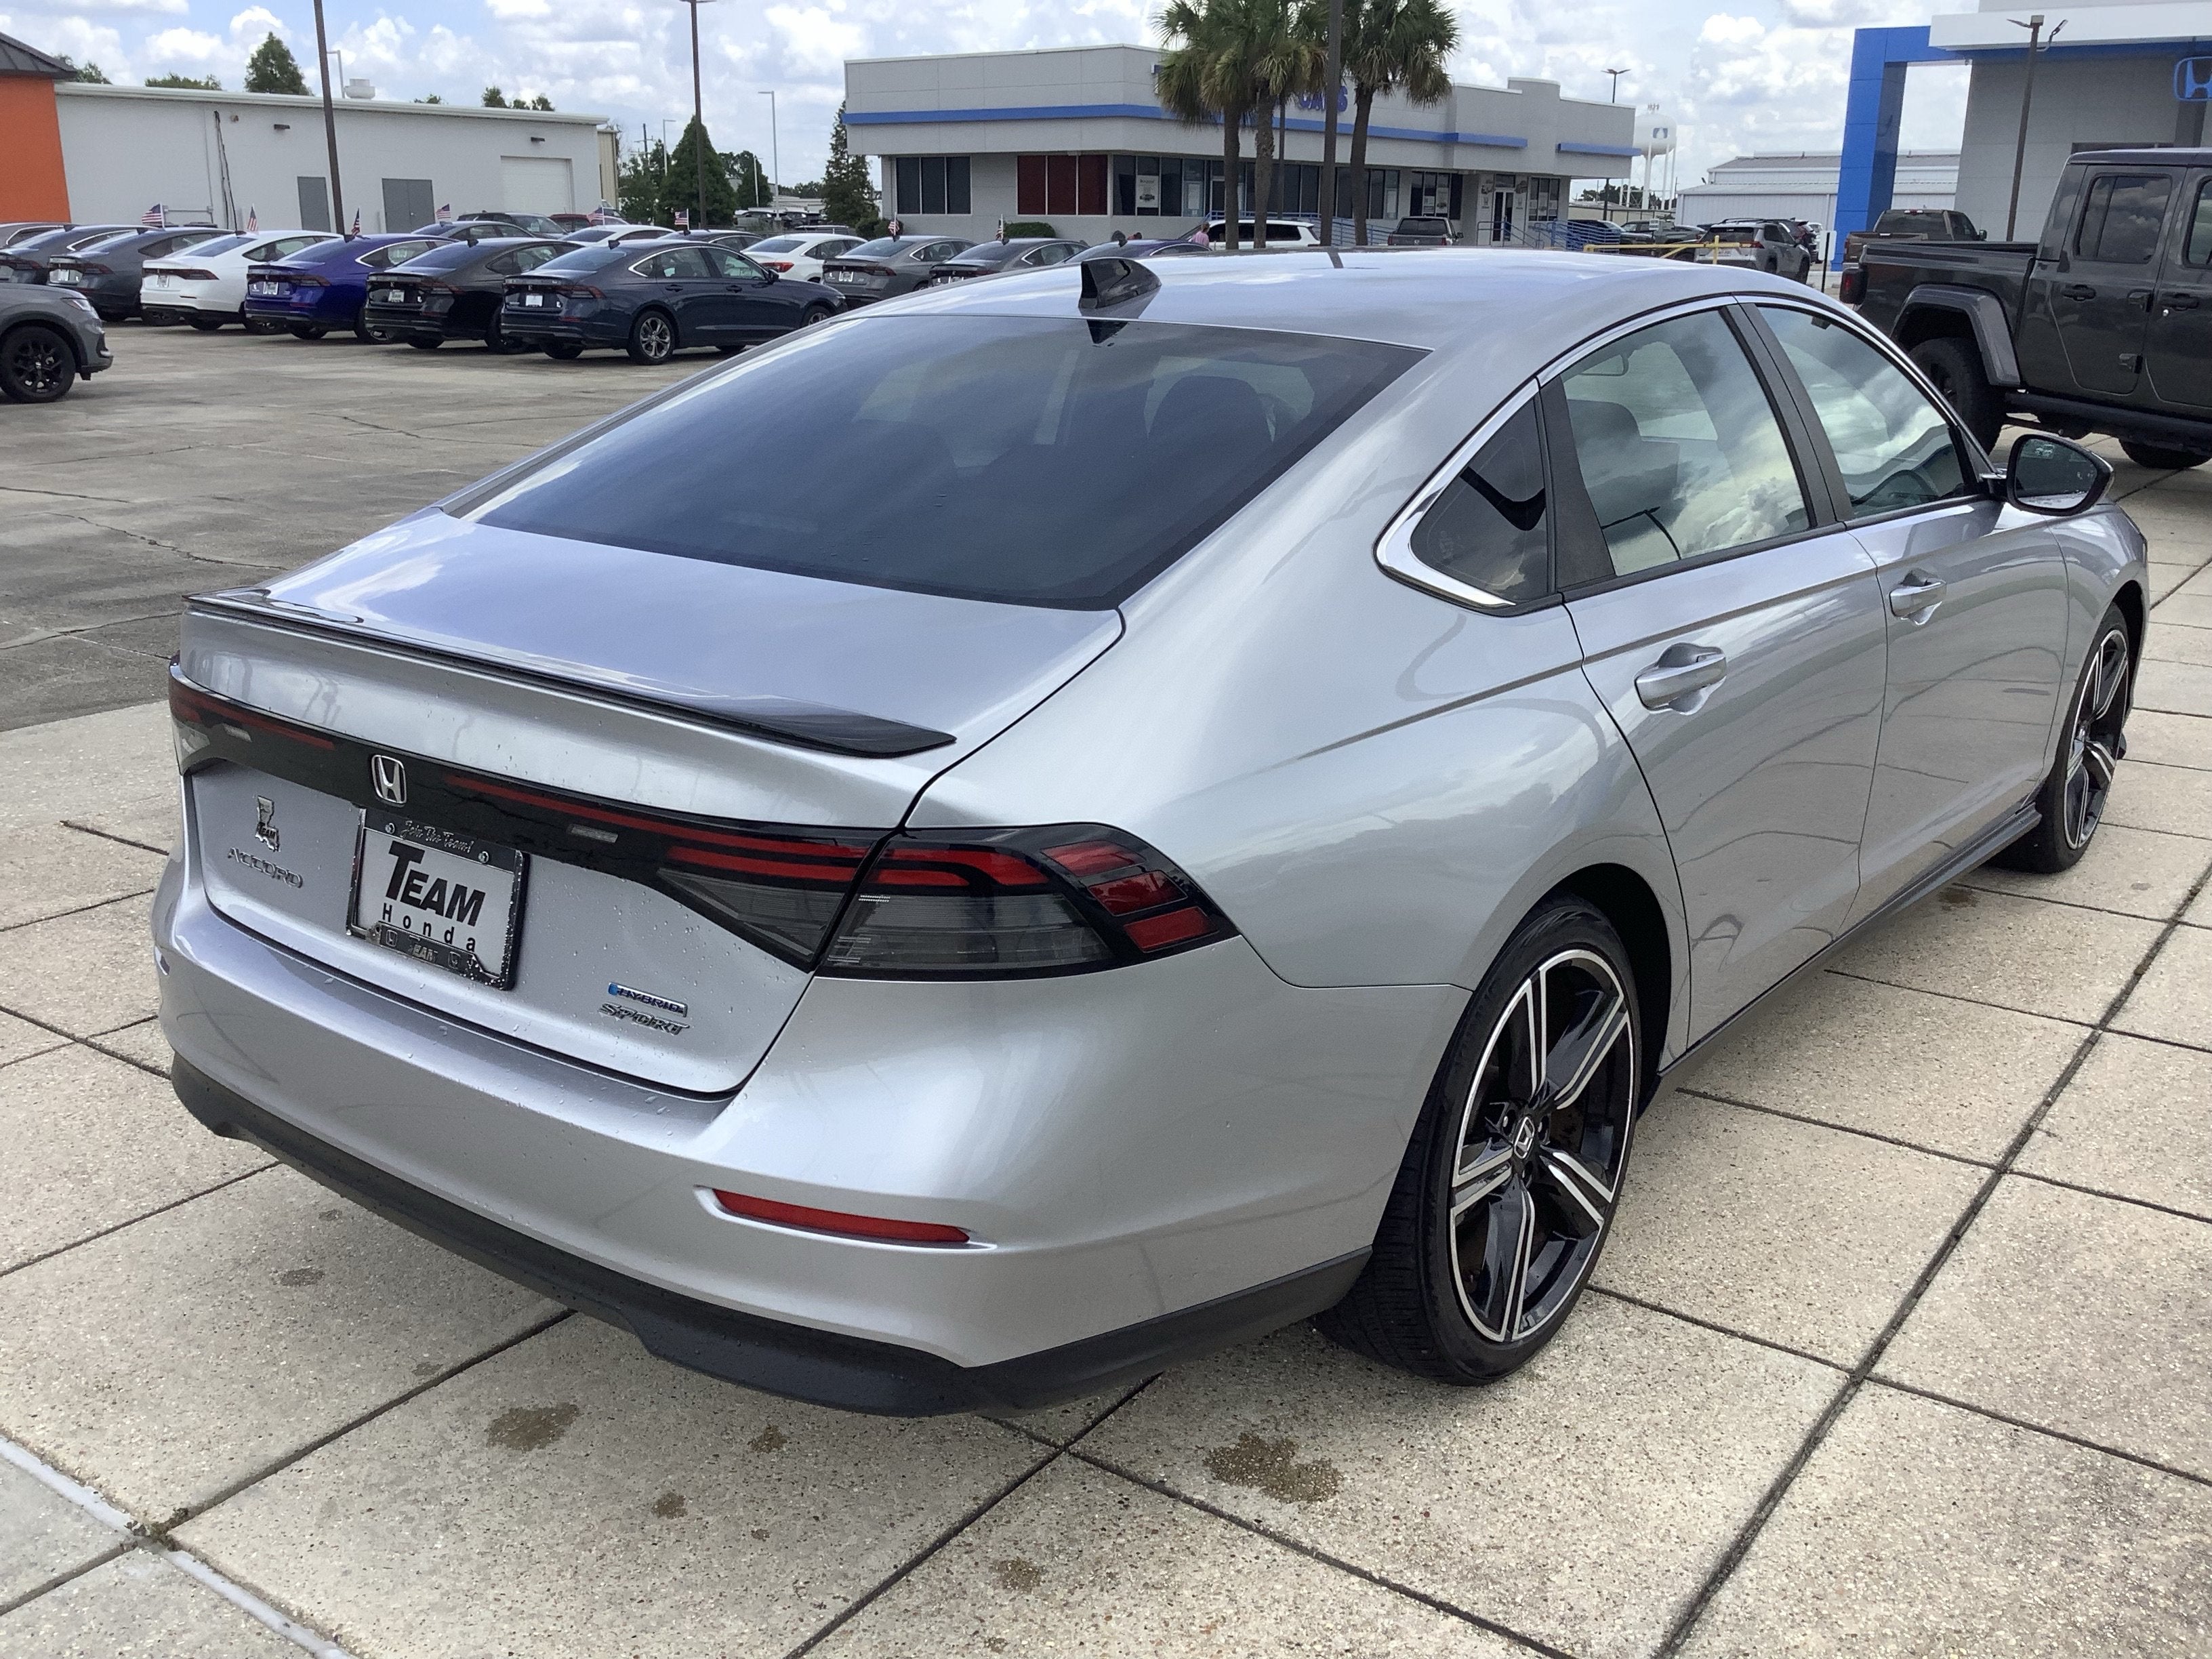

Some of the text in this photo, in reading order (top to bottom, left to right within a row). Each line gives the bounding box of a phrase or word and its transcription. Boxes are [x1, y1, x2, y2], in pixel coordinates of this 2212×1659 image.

[256, 821, 276, 840] TEAM
[424, 825, 441, 843] The
[228, 847, 303, 888] ACCORD
[386, 840, 486, 927] TEAM
[382, 903, 476, 951] Honda
[618, 988, 680, 1012] HYBRID
[599, 1002, 690, 1036] SPORT
